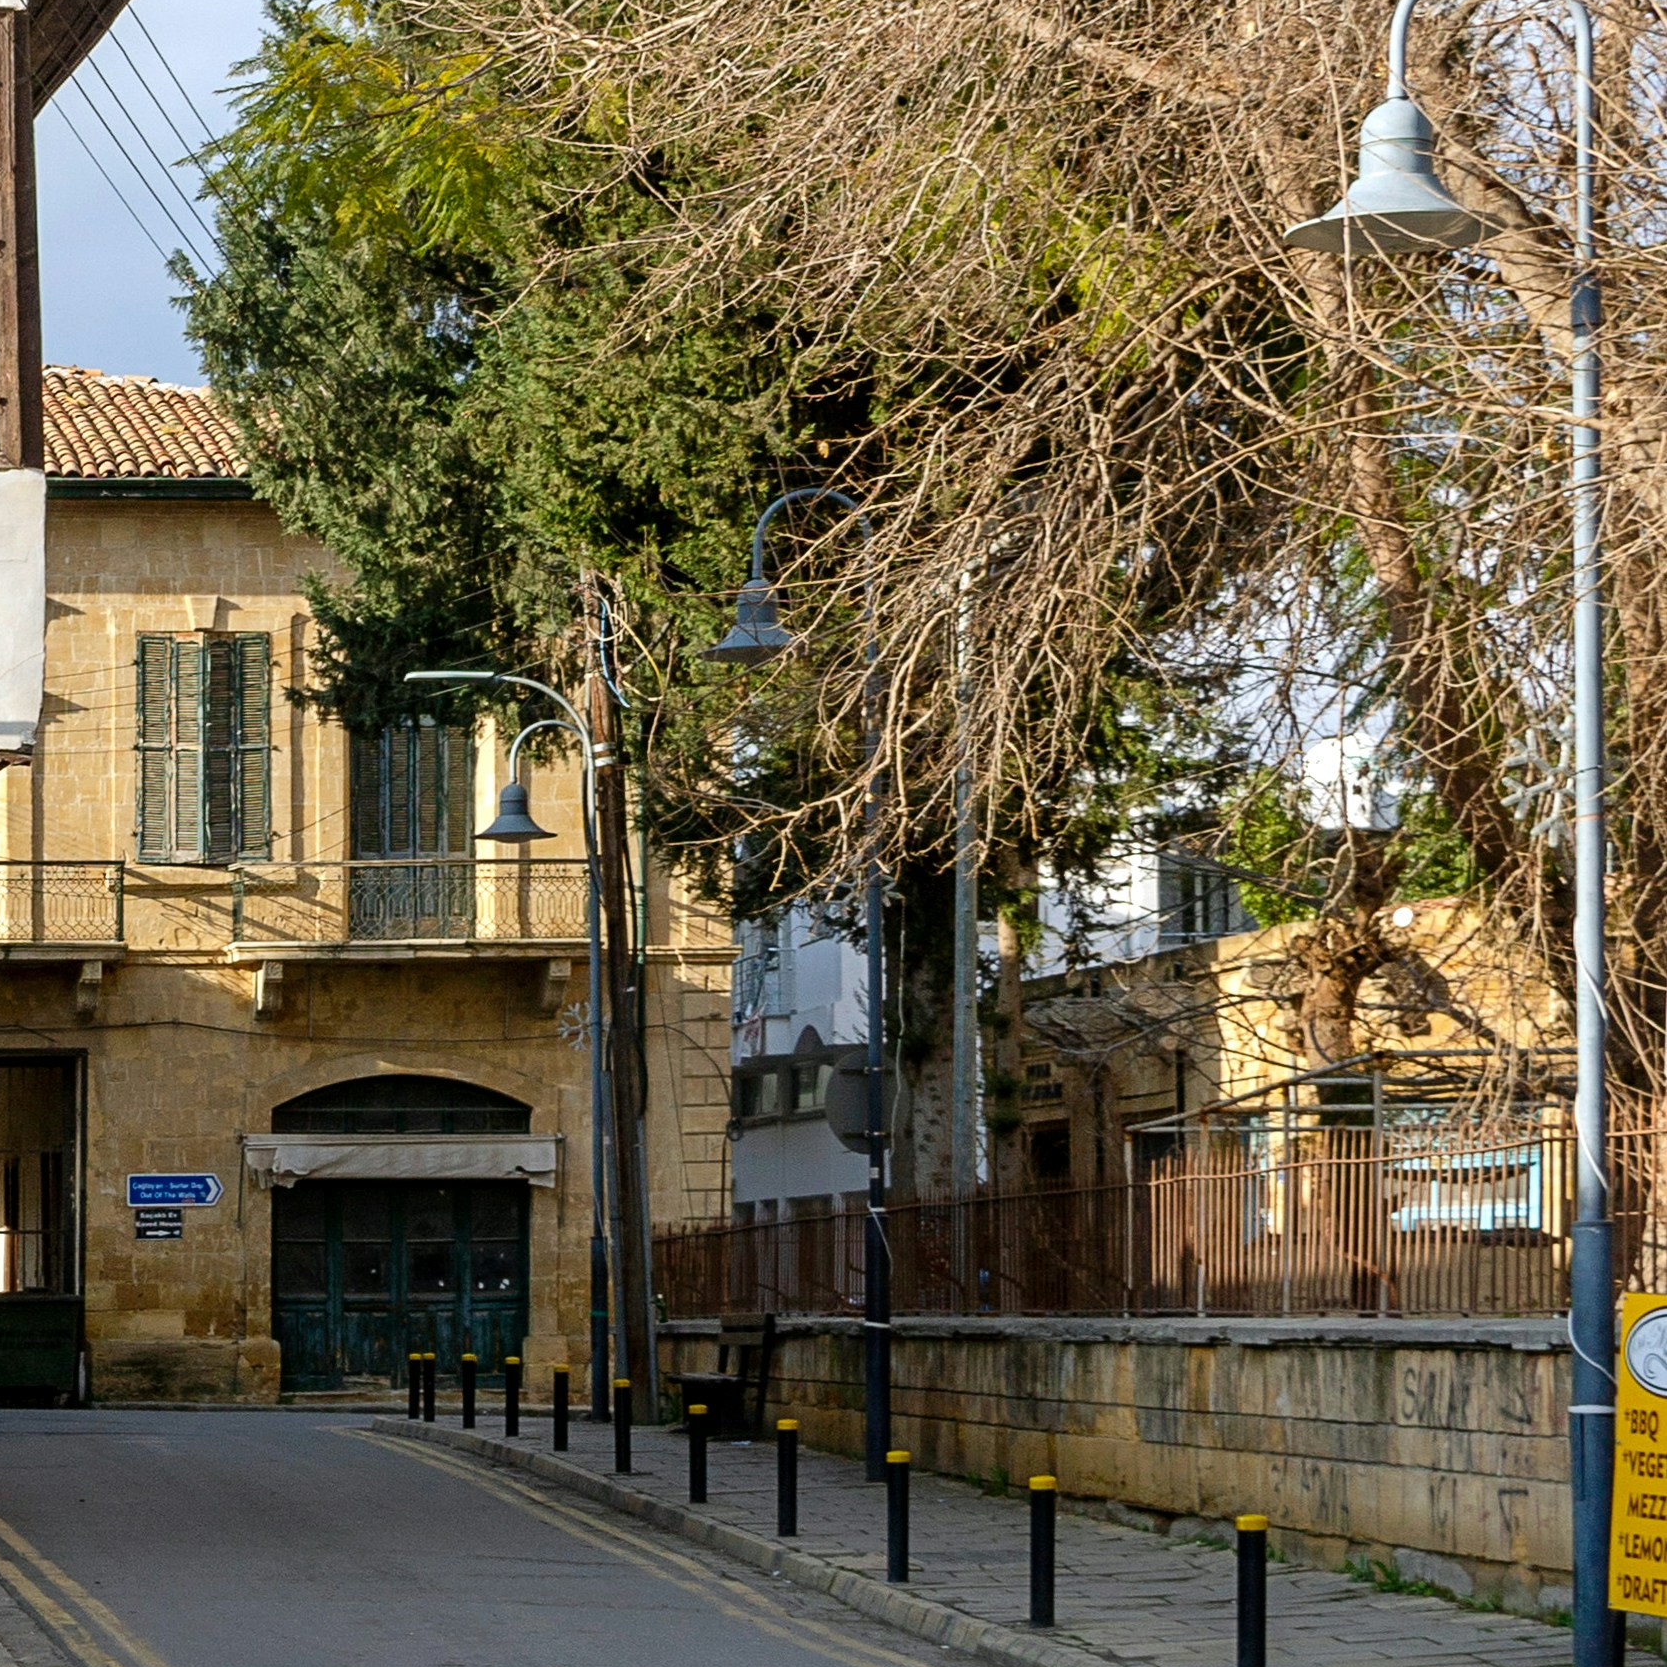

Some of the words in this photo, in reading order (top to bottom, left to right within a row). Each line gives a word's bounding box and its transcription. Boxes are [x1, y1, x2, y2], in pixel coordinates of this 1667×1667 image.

[1631, 1409, 1659, 1443] BBQ
[1628, 1450, 1667, 1478] VEGE
[1627, 1493, 1667, 1521] MEZZ
